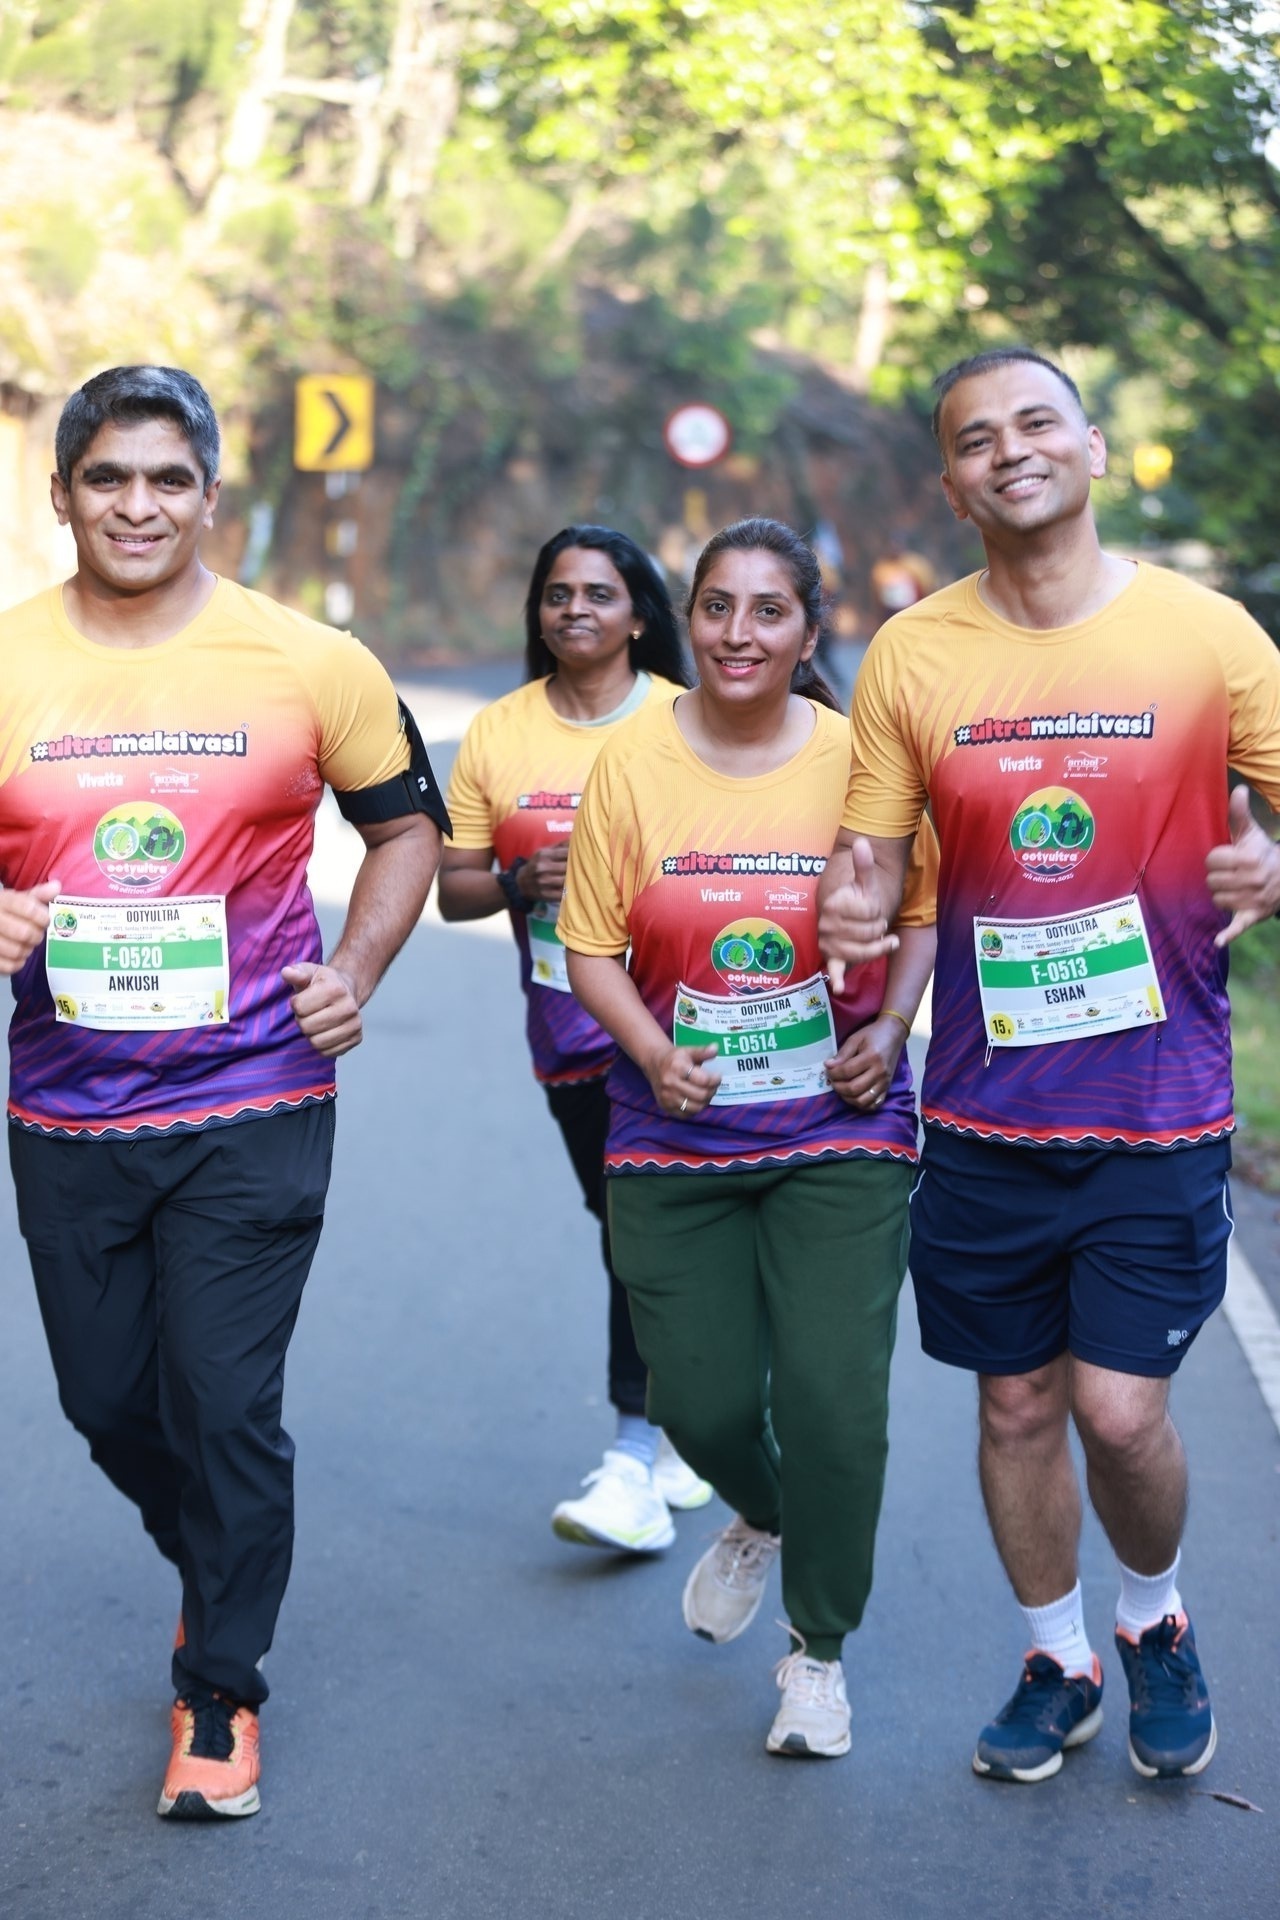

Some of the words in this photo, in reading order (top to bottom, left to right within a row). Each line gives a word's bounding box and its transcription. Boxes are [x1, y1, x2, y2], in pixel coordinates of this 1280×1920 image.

[955, 712, 1154, 746] #ultramalaivasi
[31, 730, 247, 762] #ultramalaivasi
[999, 756, 1042, 773] Vivatta
[77, 771, 124, 788] Vivatta
[1022, 850, 1078, 864] ootyultra
[106, 863, 168, 876] ootyultra
[701, 889, 741, 902] Vivatta
[126, 909, 180, 923] OOTYULTRA
[1045, 918, 1099, 939] OOTYULTRA
[102, 946, 163, 969] F-0520
[1030, 957, 1088, 985] F-0513
[108, 975, 160, 991] ANKUSH
[728, 973, 780, 987] ootyultra
[1044, 984, 1087, 1005] ESHAN
[58, 999, 70, 1015] 15
[740, 997, 791, 1017] OOTYULTRA
[993, 1019, 1006, 1034] 15
[722, 1032, 778, 1055] F-0514
[737, 1056, 770, 1072] ROMI
